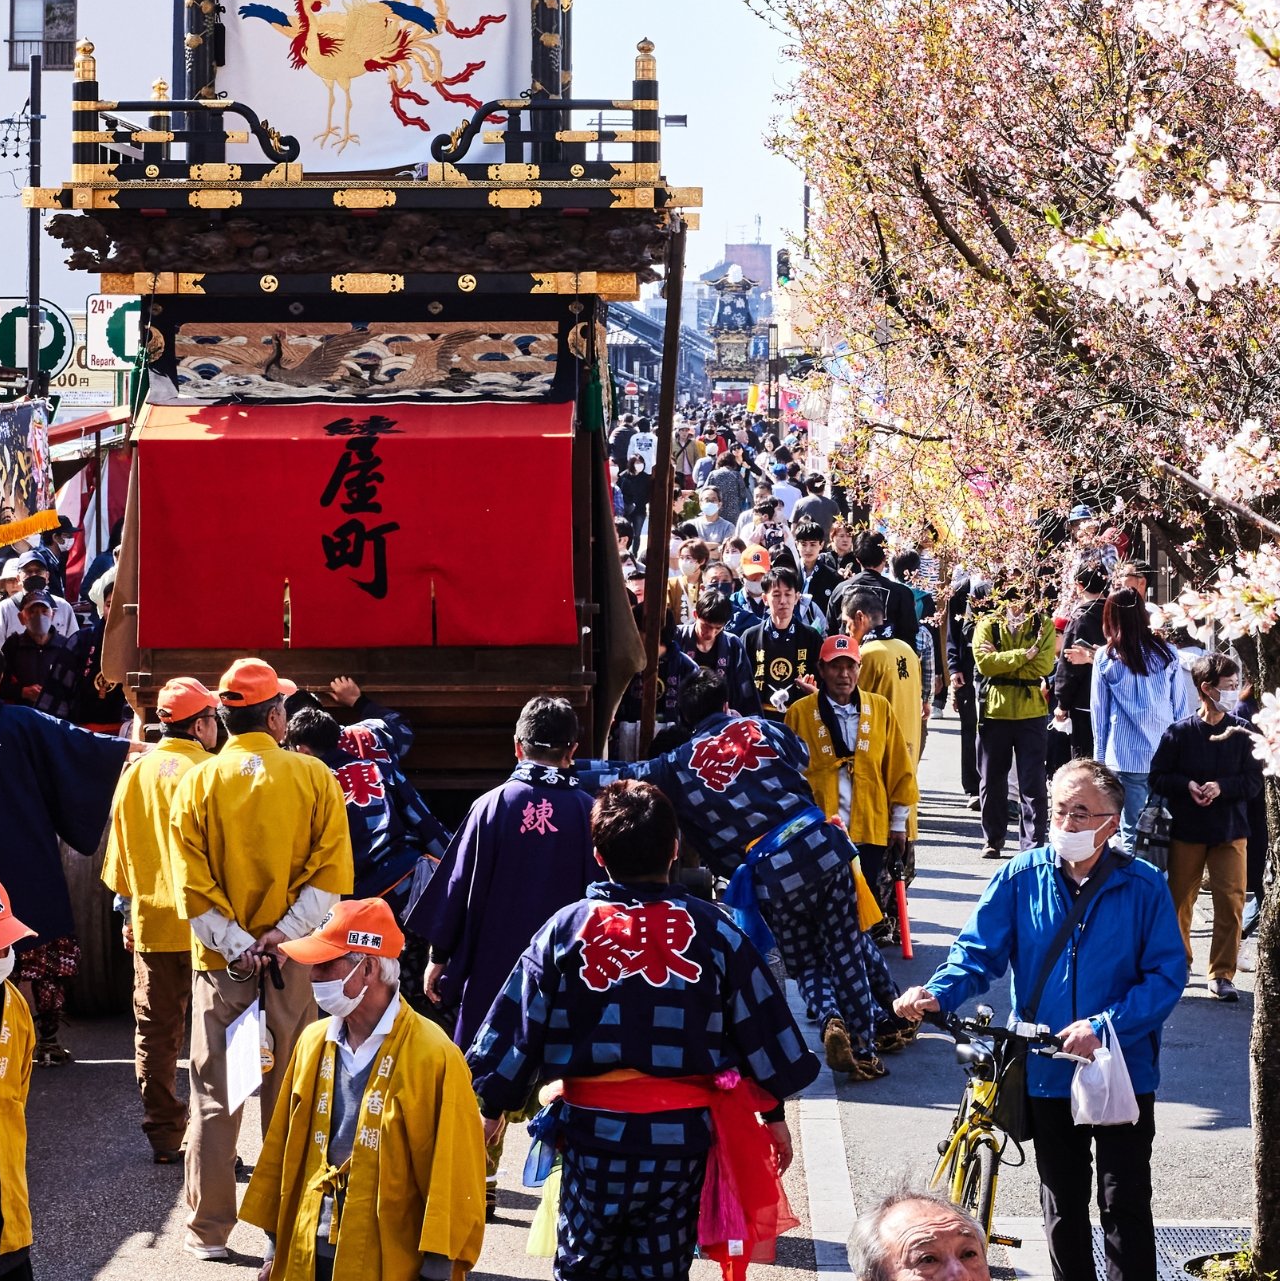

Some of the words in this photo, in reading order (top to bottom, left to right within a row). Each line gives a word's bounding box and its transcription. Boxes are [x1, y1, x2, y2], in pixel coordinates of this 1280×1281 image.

[91, 299, 112, 314] 24h
[90, 354, 116, 367] Repark
[520, 797, 560, 836] 練
